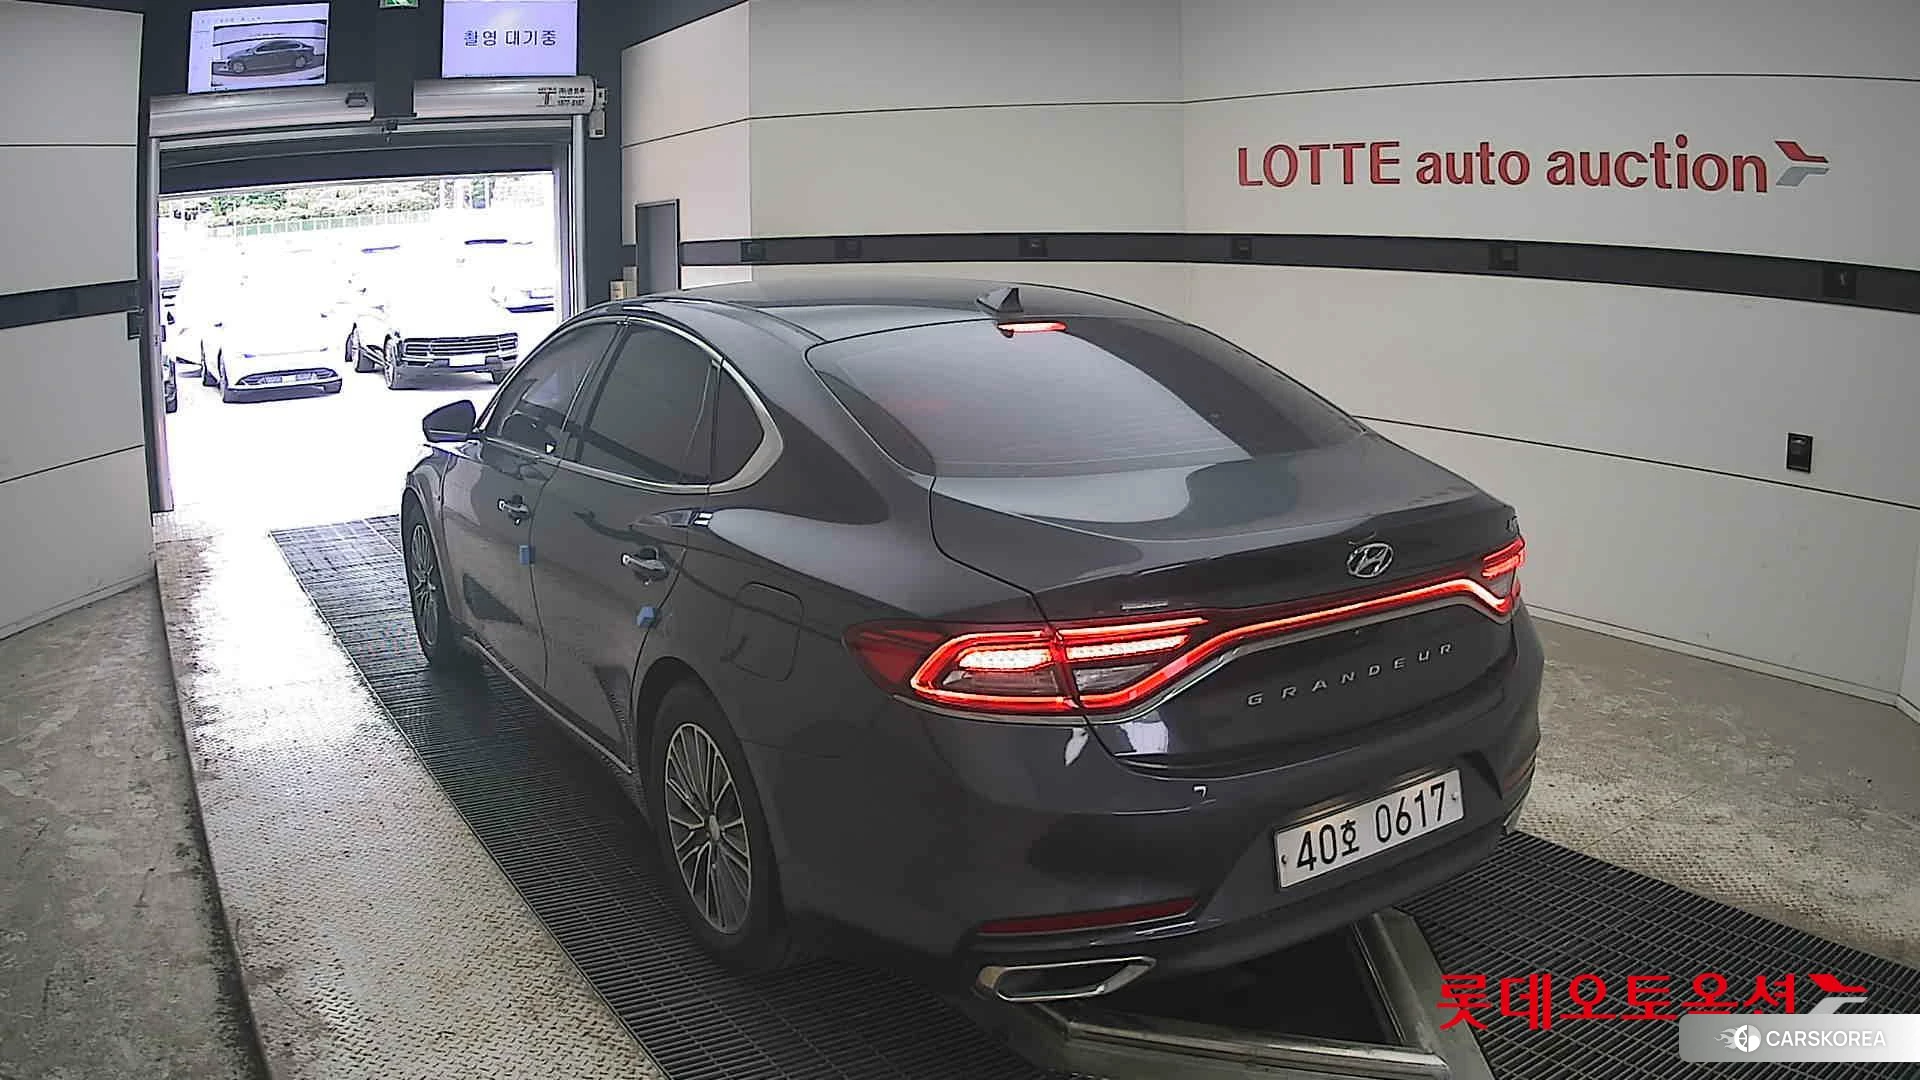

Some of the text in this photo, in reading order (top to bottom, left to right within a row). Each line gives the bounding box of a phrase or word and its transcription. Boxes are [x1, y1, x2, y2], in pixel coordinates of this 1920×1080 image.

[505, 30, 557, 47] 대기중
[1238, 133, 1768, 193] LOTTE auto auction
[1247, 643, 1452, 706] GRANDEUR
[1296, 781, 1446, 872] 40호 0617
